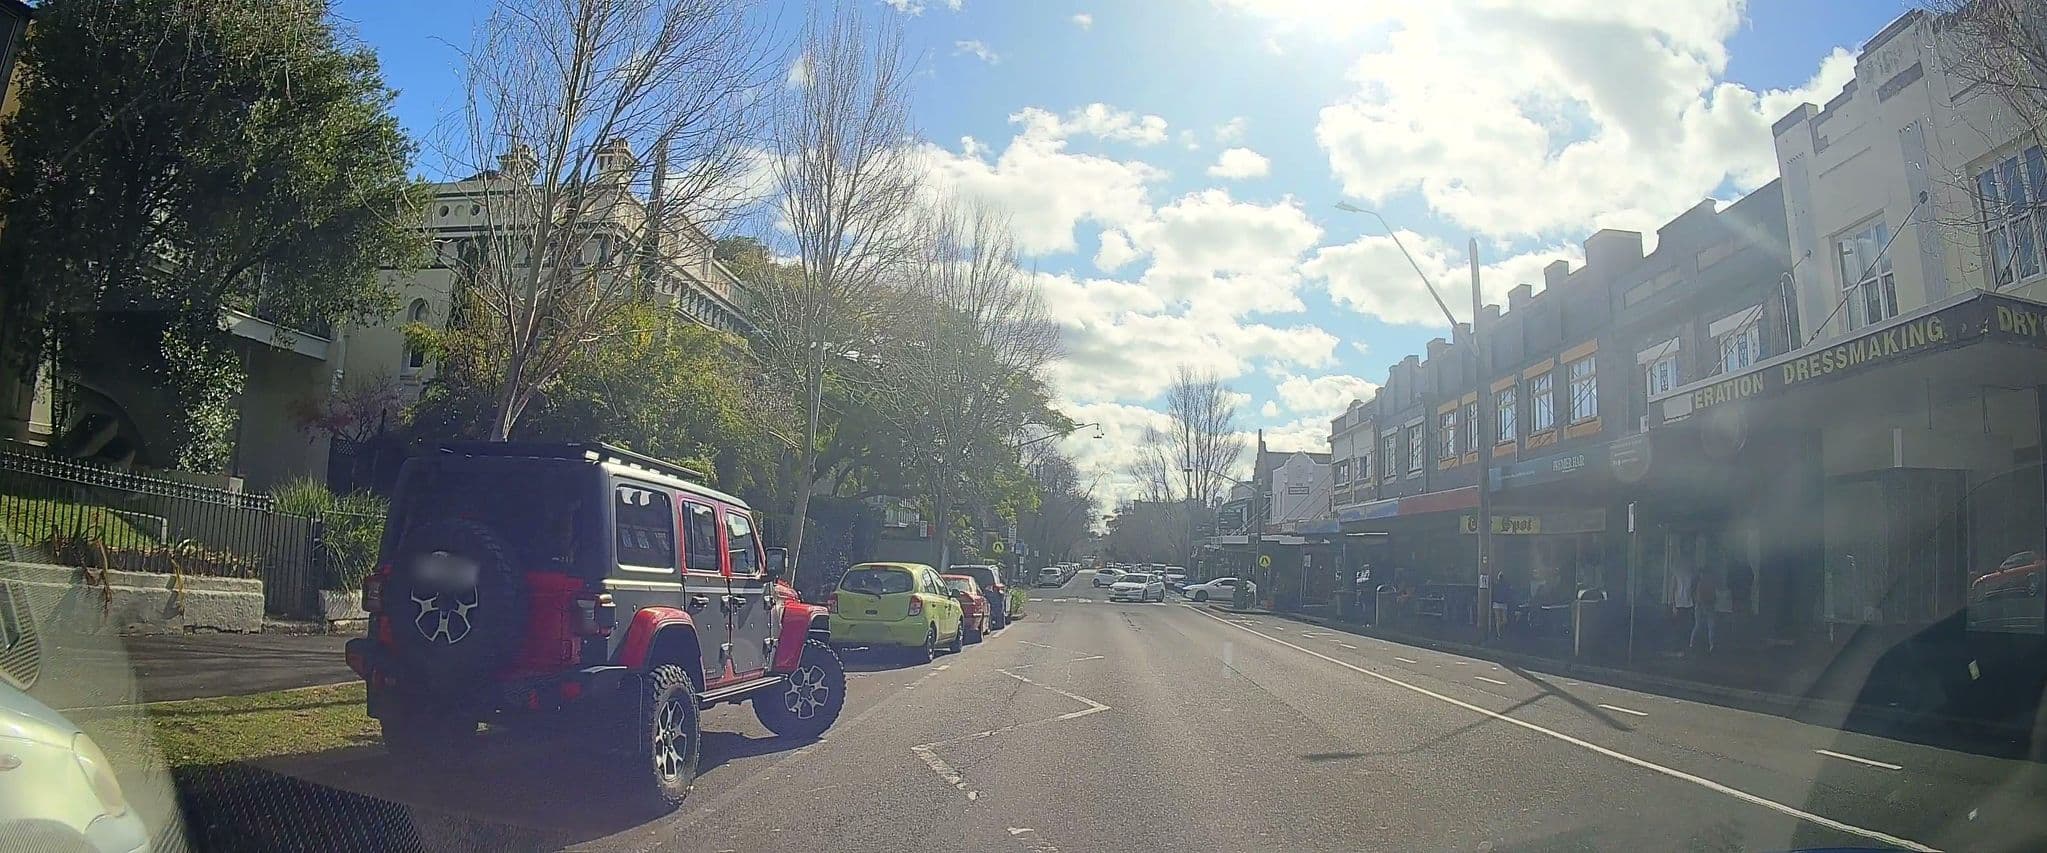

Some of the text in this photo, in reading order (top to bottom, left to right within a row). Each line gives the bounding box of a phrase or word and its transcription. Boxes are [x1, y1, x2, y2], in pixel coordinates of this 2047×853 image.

[1996, 305, 2038, 336] DRY
[1691, 316, 1945, 409] ERATION DRESSMAKING
